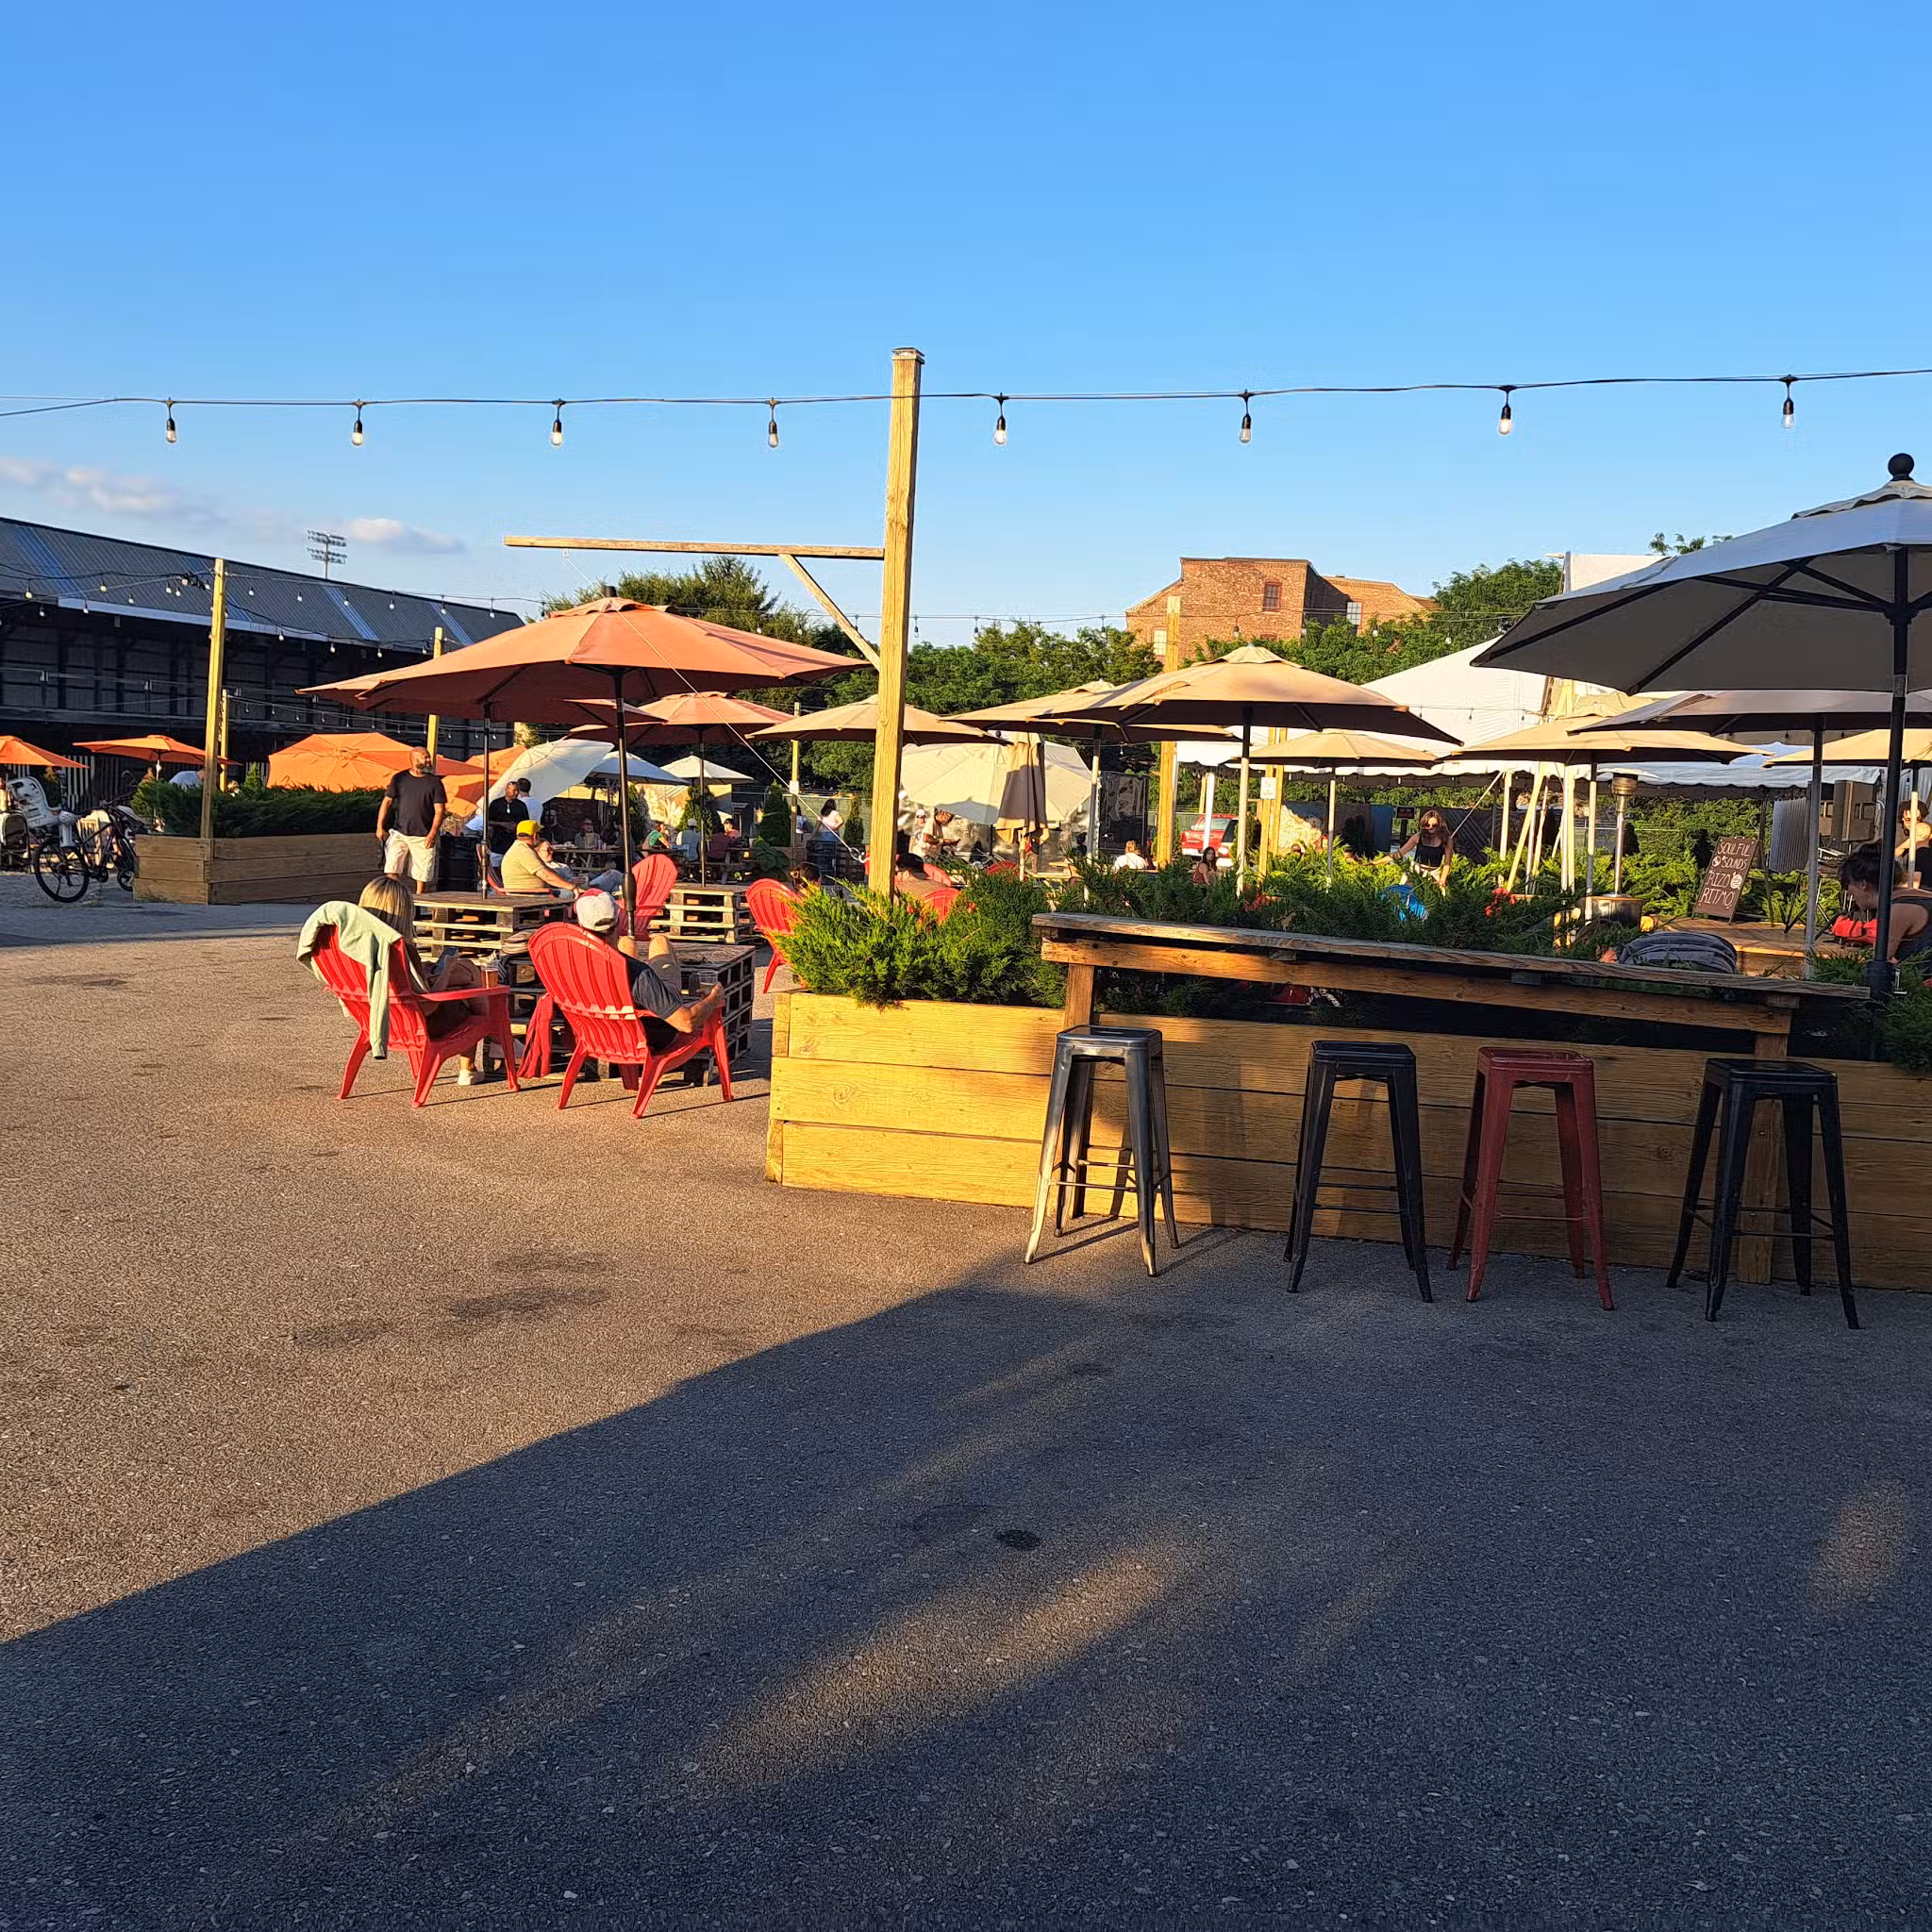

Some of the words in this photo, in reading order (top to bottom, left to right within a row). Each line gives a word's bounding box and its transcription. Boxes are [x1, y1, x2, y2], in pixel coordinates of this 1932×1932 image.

[1717, 841, 1751, 857] SOULFUL
[1721, 857, 1749, 871] SOUNDS
[1705, 871, 1731, 888] RIZO
[1698, 887, 1736, 906] RITMO
